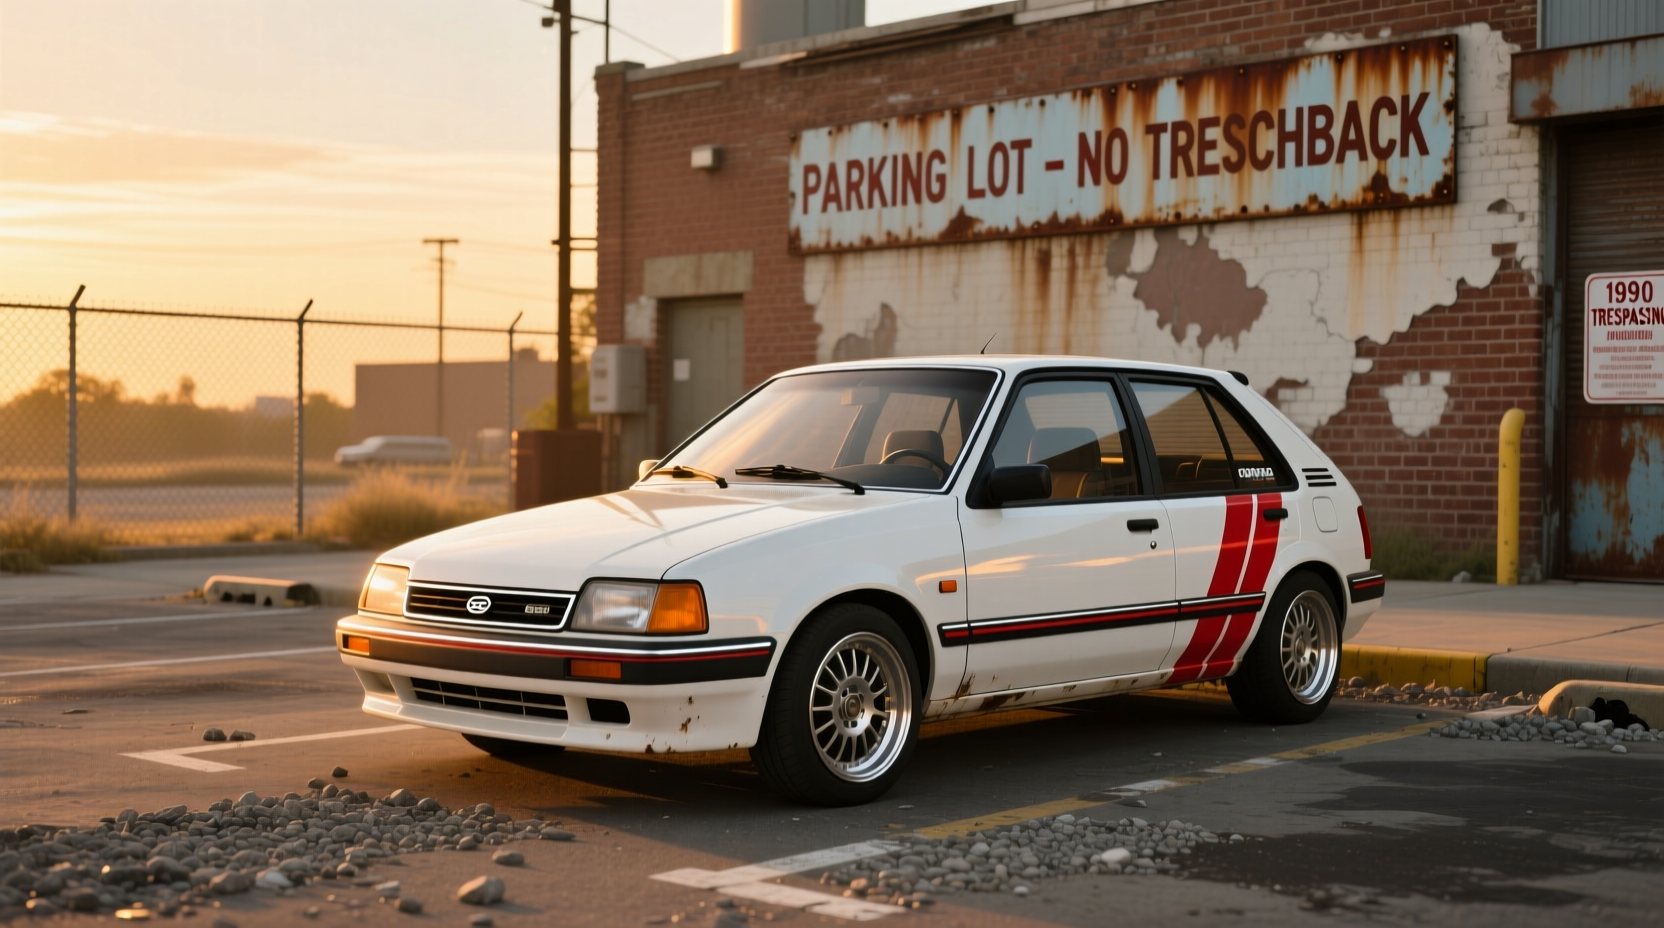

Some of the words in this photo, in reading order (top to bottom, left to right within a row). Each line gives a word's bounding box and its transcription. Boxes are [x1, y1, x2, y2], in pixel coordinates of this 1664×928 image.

[803, 149, 946, 215] PARKING
[968, 138, 1032, 199] LOT
[1078, 127, 1129, 188] NO
[1145, 92, 1431, 180] TRESCHBACK
[1606, 280, 1653, 303] 1990
